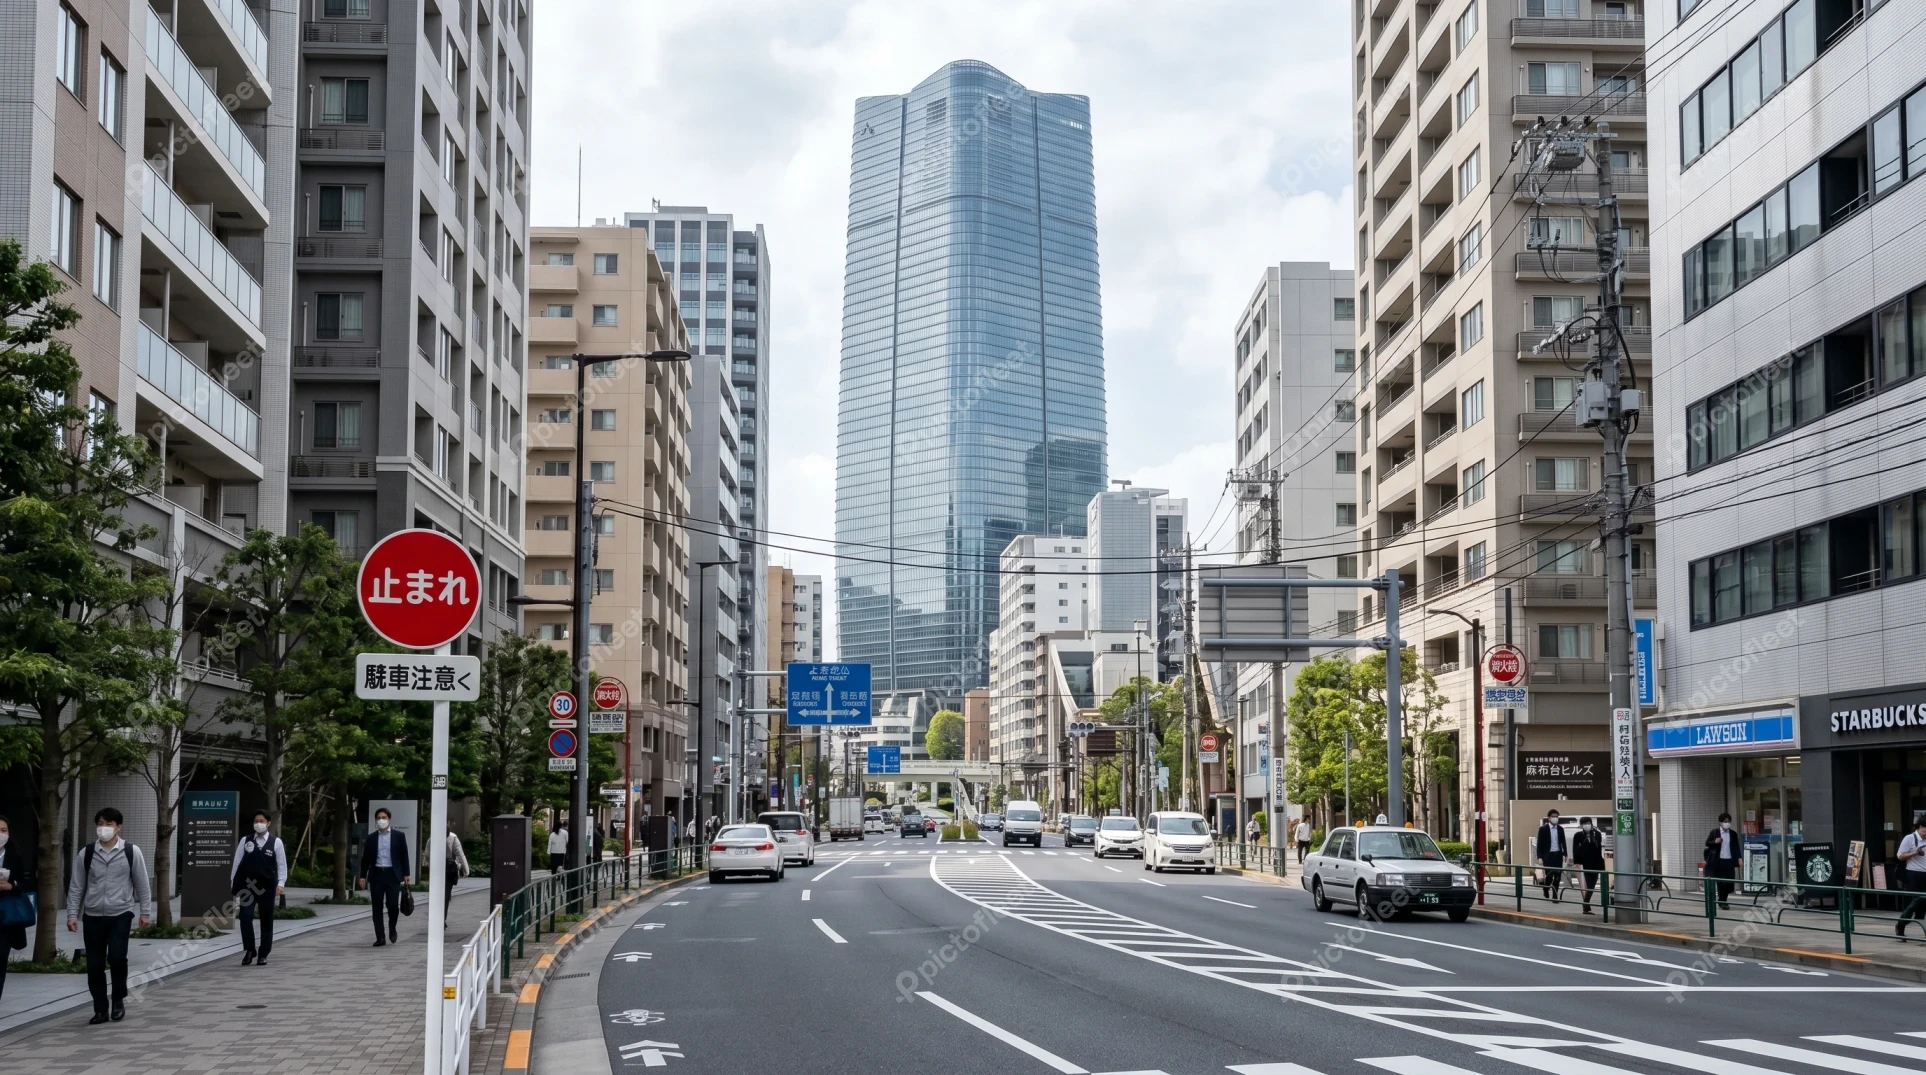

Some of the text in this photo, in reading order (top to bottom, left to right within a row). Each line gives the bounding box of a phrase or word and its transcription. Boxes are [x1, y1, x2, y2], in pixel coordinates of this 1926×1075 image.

[368, 567, 471, 605] 止まれ
[556, 699, 570, 711] 30
[1831, 703, 1926, 732] STARBUCKS
[1696, 722, 1747, 744] LAWSON
[1525, 763, 1594, 776] 麻布台ヒルズ
